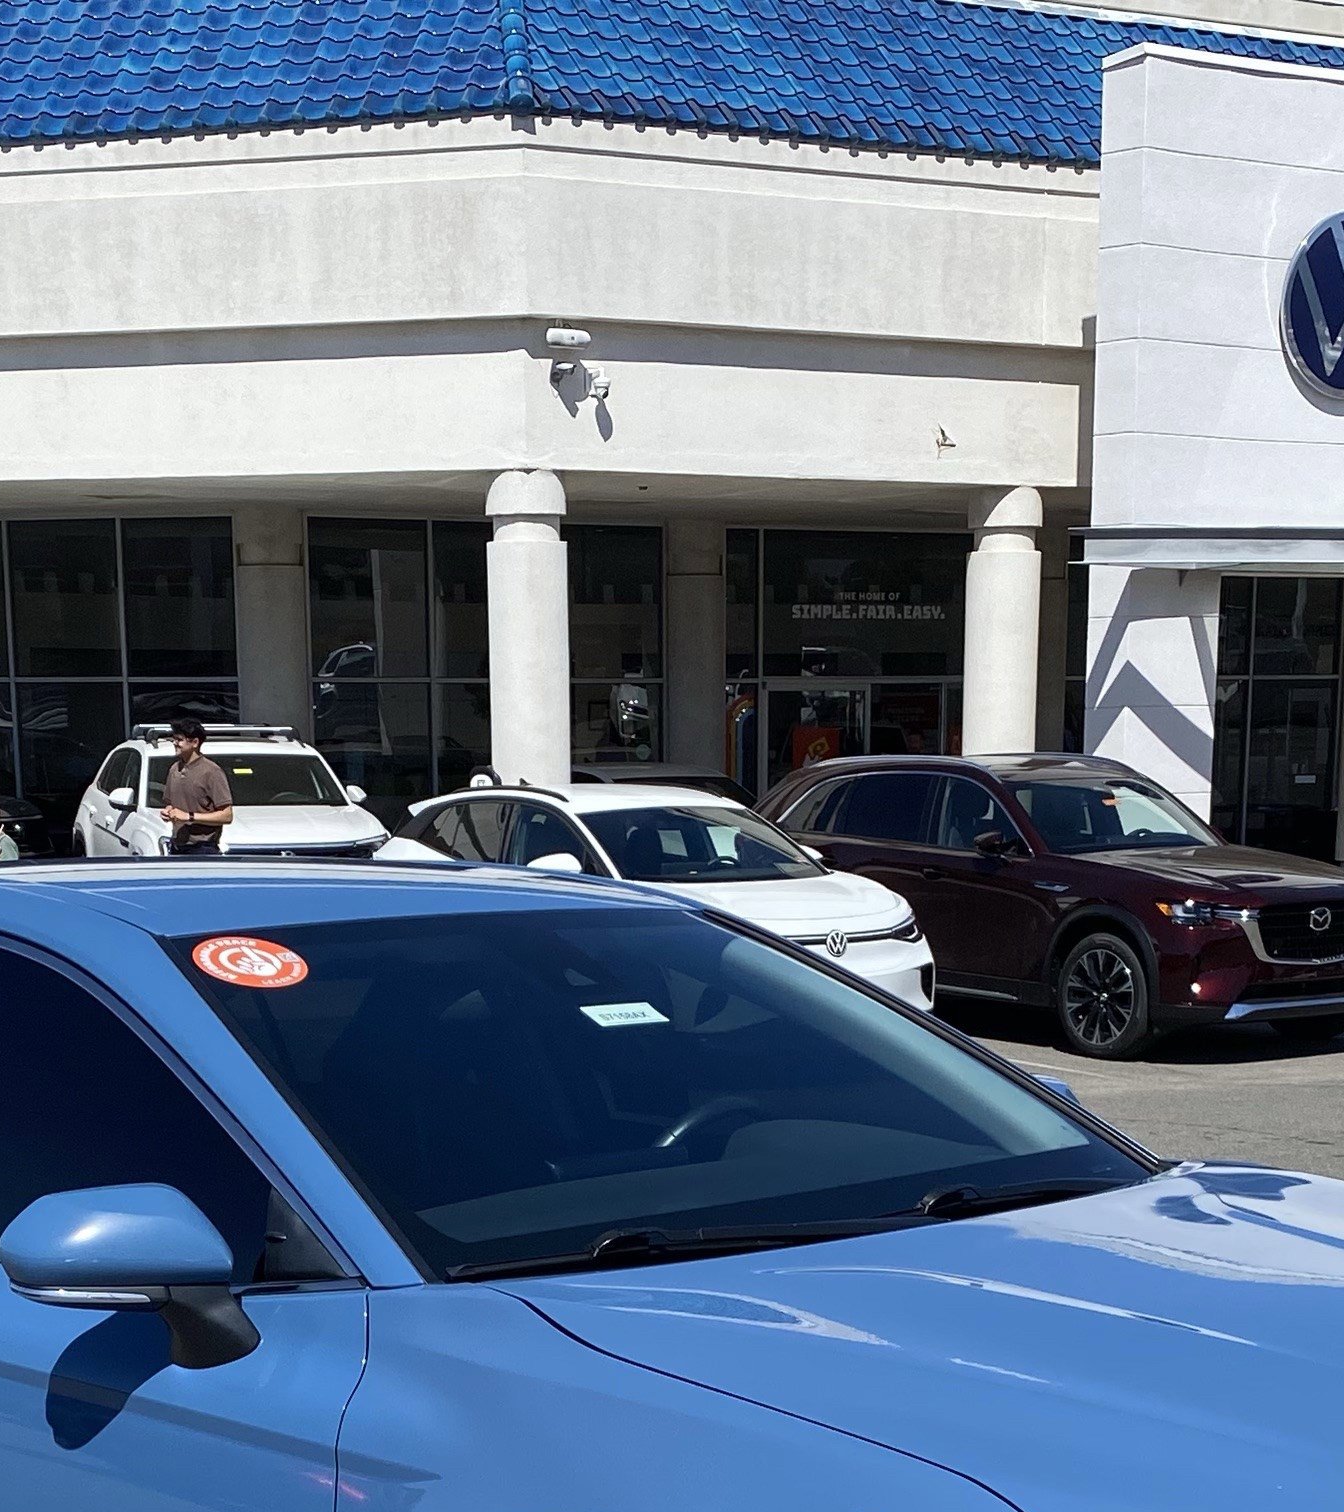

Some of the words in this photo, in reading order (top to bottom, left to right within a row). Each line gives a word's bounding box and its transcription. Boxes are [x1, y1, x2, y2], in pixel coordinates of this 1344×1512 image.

[839, 591, 855, 601] THE
[858, 591, 886, 601] HOME
[888, 591, 901, 601] OF
